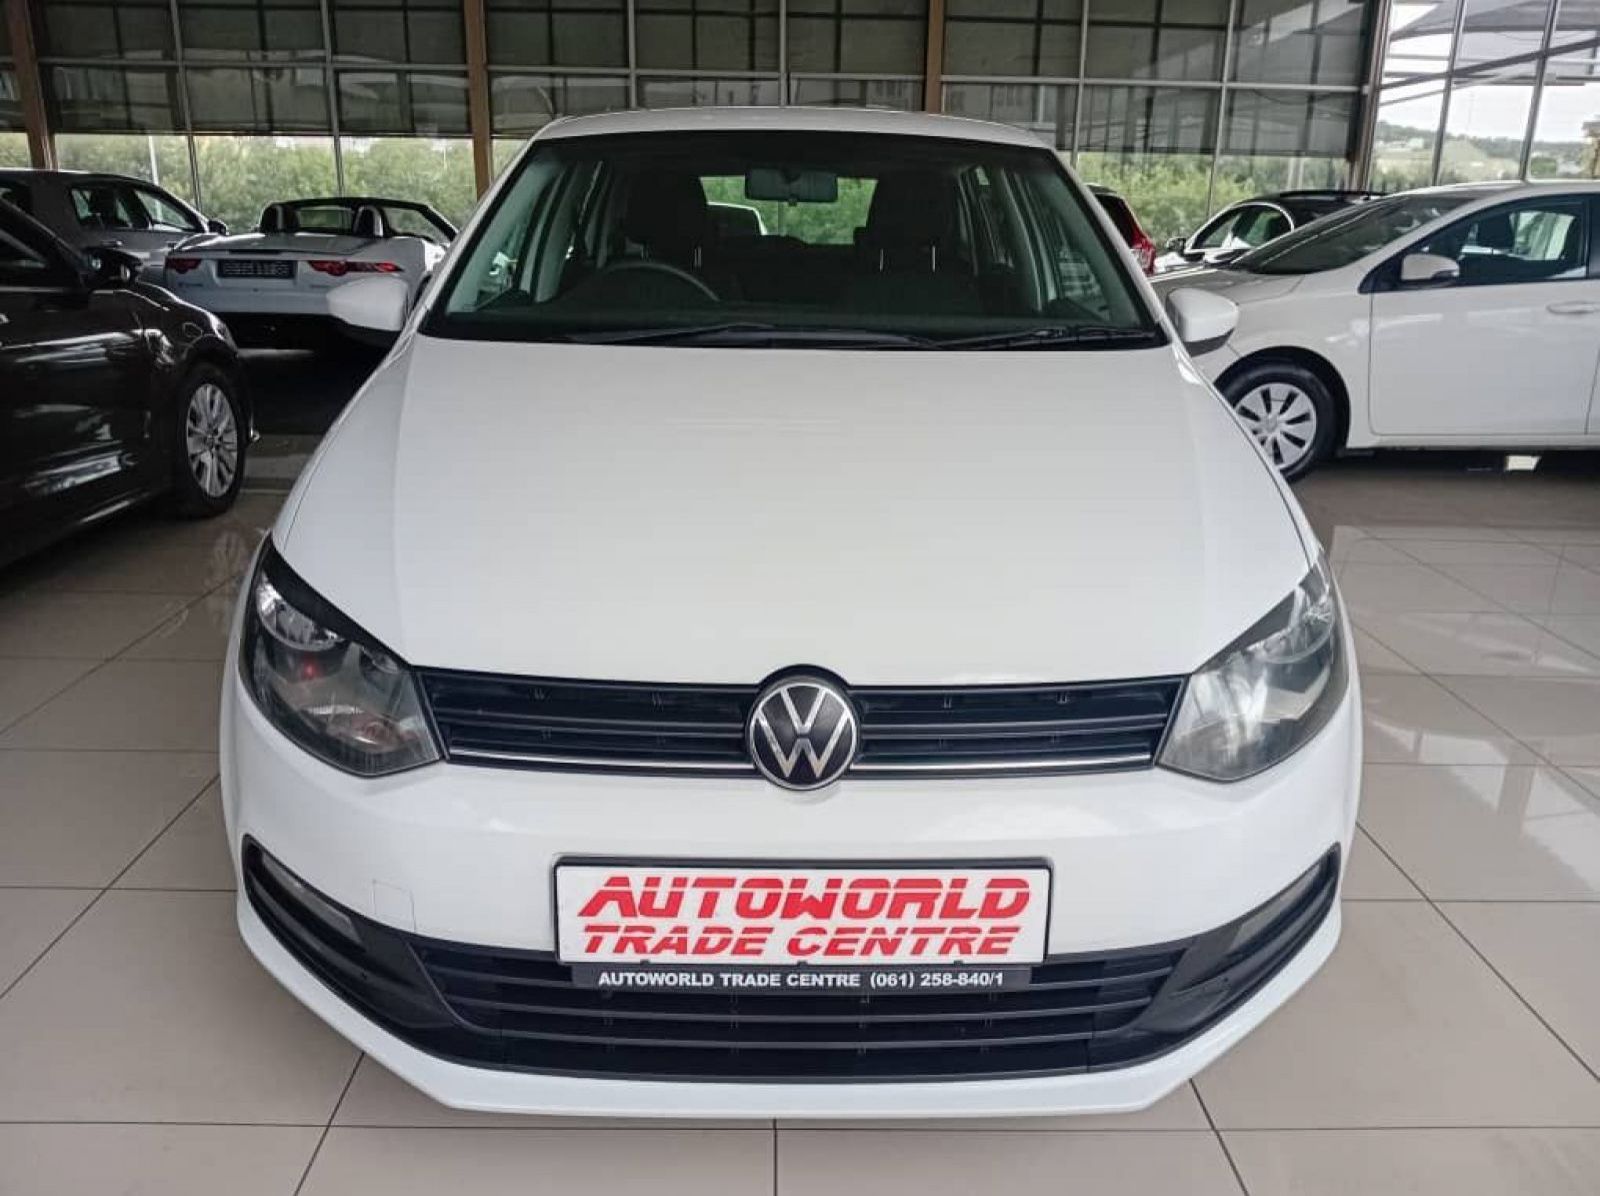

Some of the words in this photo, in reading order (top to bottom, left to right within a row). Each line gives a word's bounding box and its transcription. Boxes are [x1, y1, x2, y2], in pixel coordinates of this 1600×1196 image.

[577, 876, 1030, 920] AUTOWORLD
[583, 925, 775, 956] TRADE
[786, 926, 1022, 956] CENTRE
[599, 972, 714, 988] AUTOWORLD
[719, 973, 781, 987] TRADE
[786, 973, 861, 988] CENTRE
[870, 972, 915, 988] (061)
[920, 971, 1004, 988] 258-840/1
